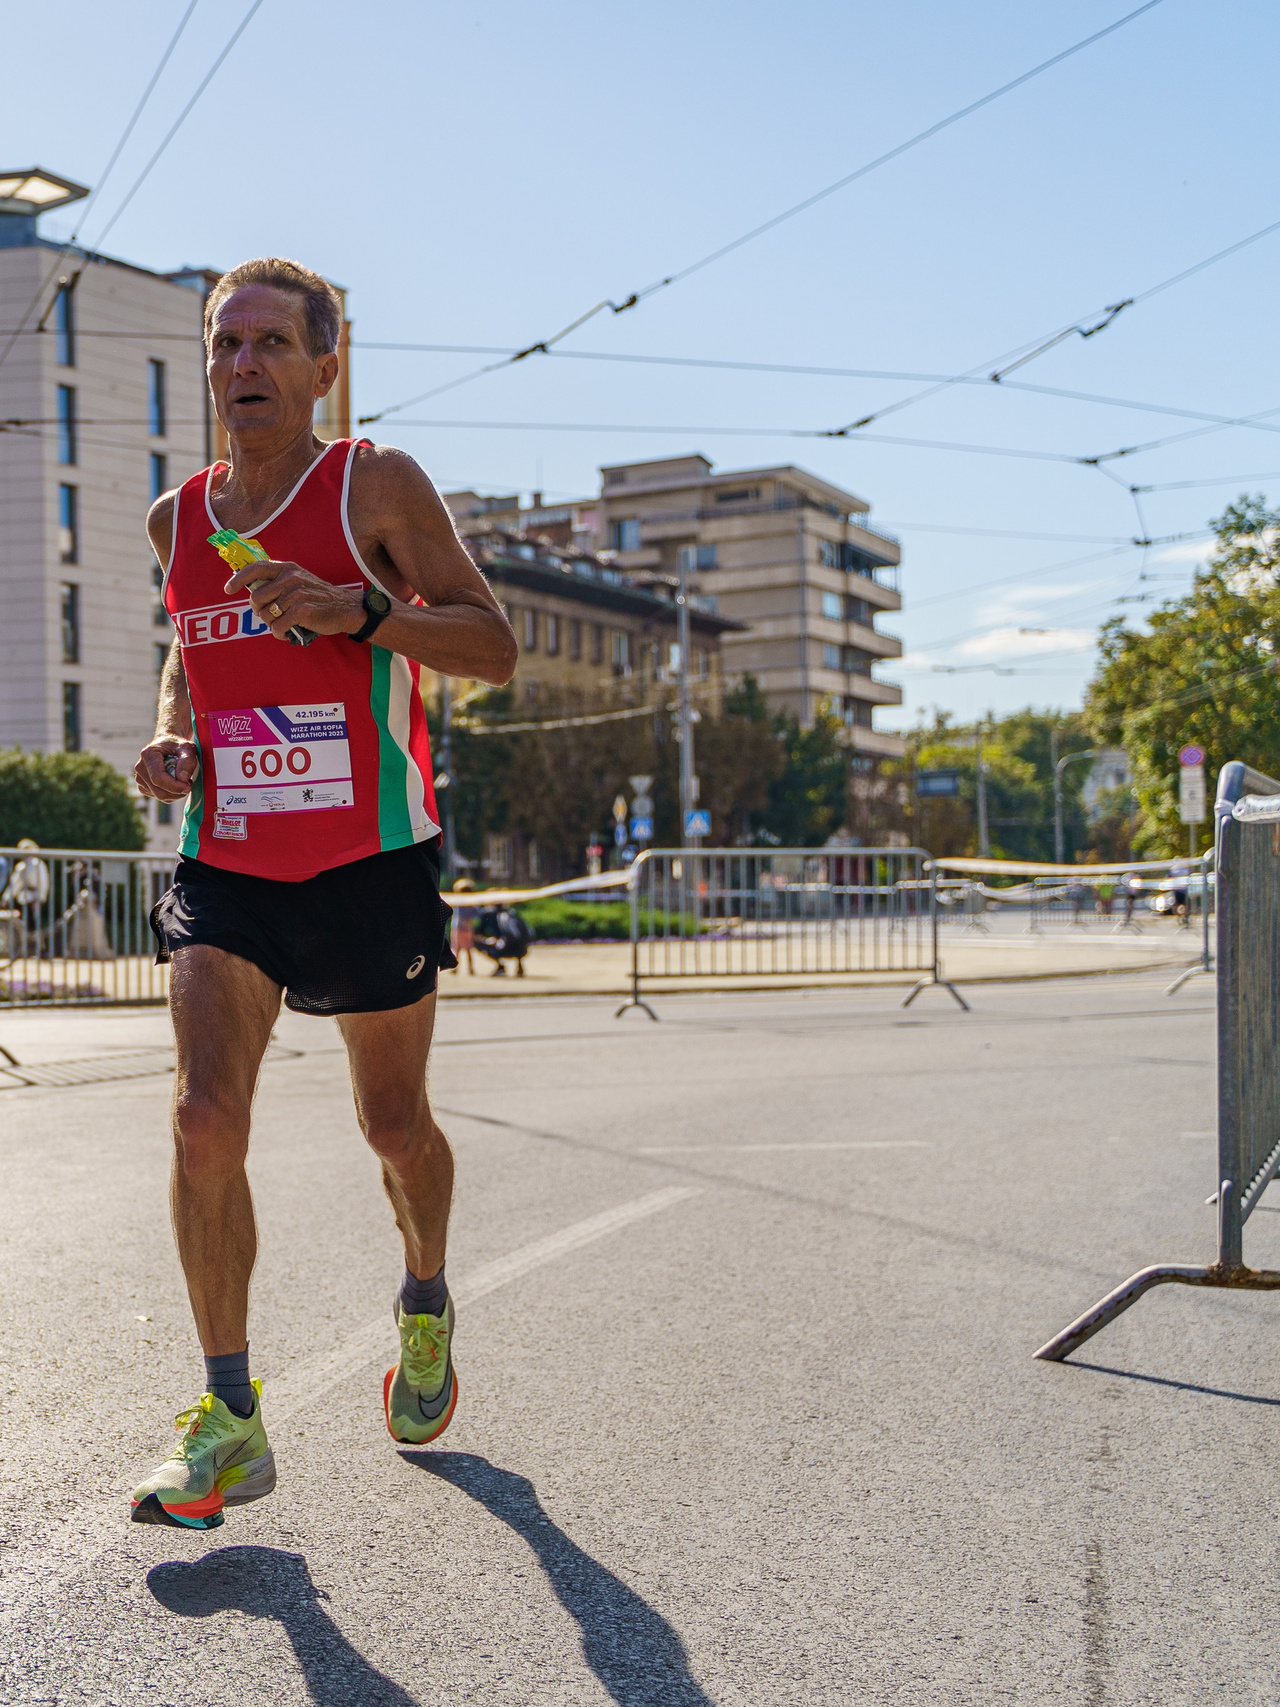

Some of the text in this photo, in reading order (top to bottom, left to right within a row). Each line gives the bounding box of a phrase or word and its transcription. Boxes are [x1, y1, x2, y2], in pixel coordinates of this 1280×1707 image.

[295, 710, 324, 719] 42.195
[290, 725, 309, 733] WIZZ
[290, 731, 328, 740] MARATHON
[241, 746, 312, 778] 600
